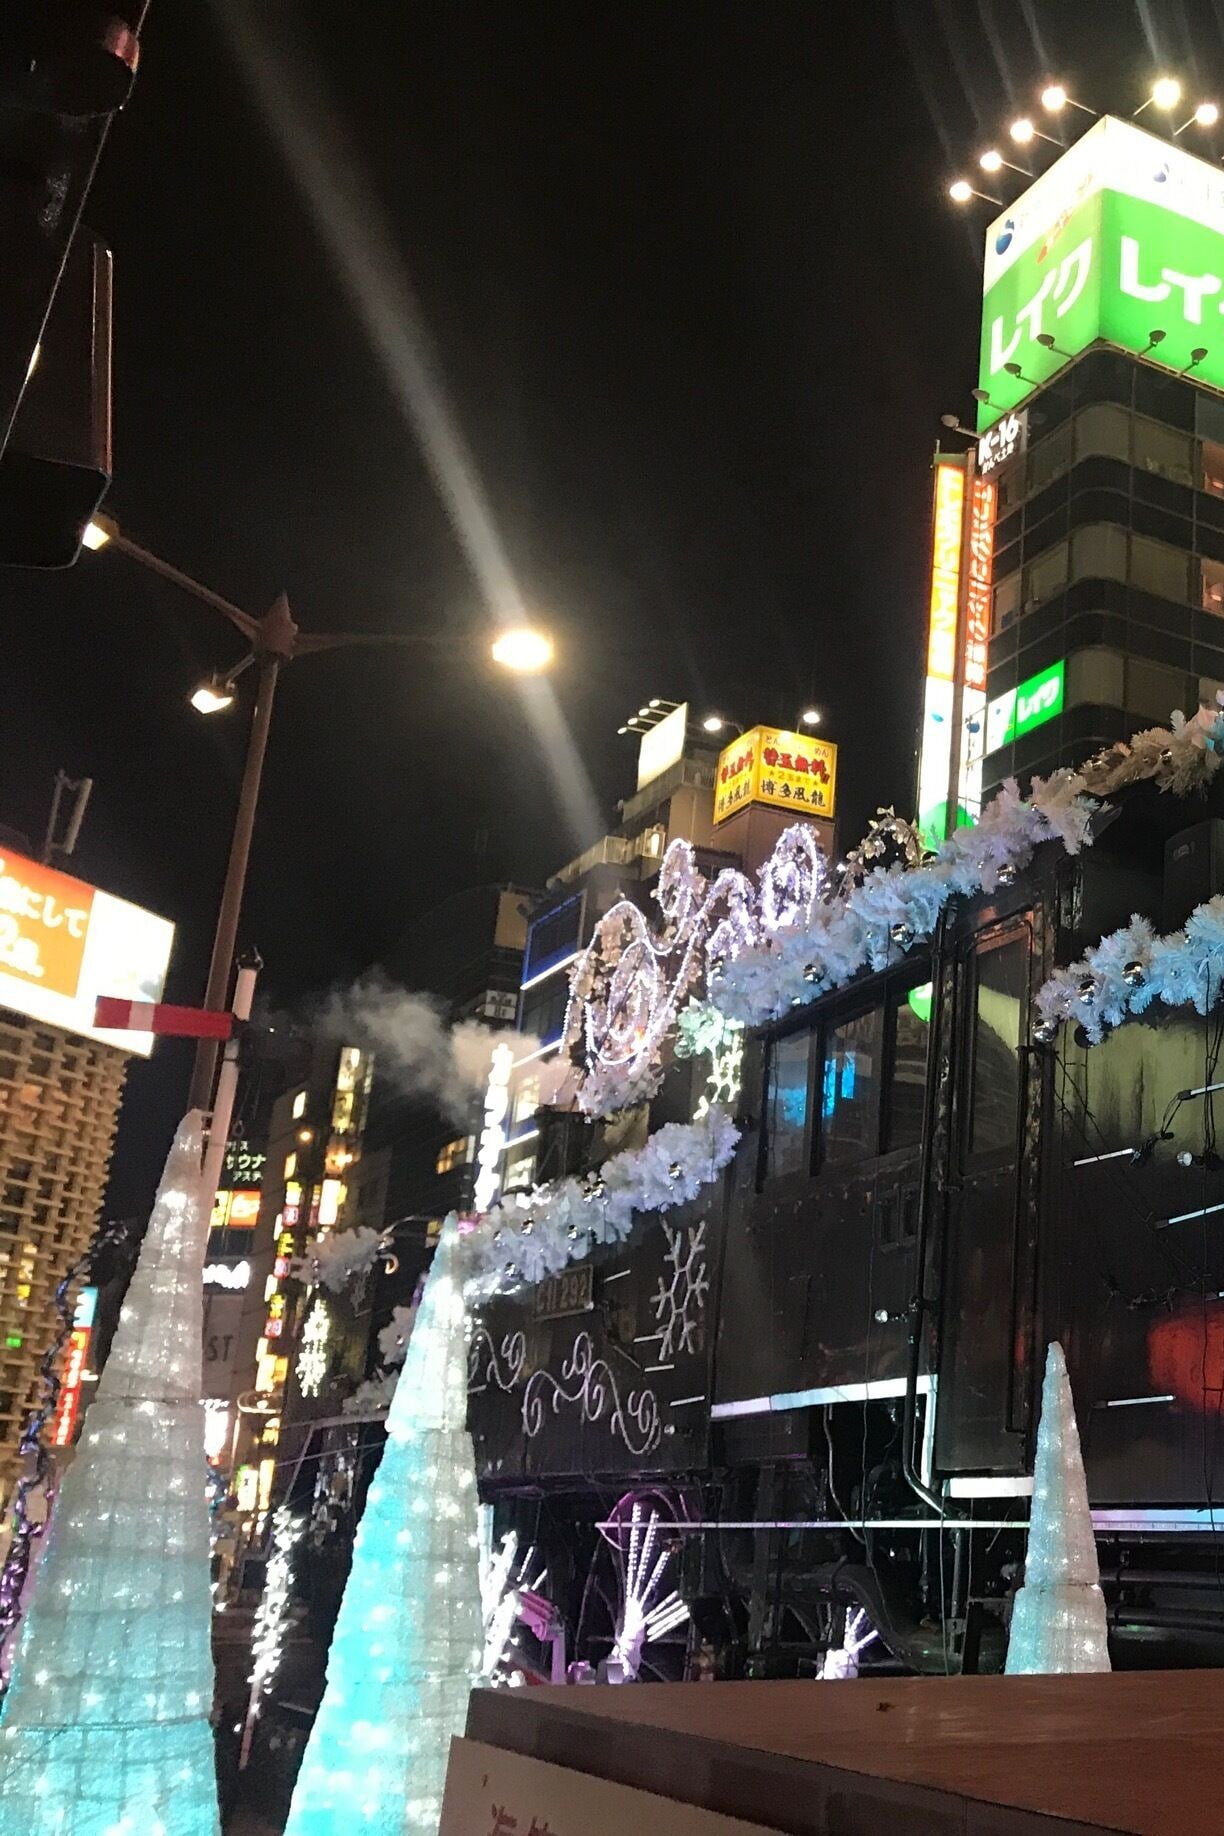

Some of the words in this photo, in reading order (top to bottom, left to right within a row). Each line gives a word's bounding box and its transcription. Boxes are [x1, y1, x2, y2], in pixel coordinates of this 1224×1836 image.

[990, 237, 1093, 376] レイク
[1017, 675, 1060, 725] レイク
